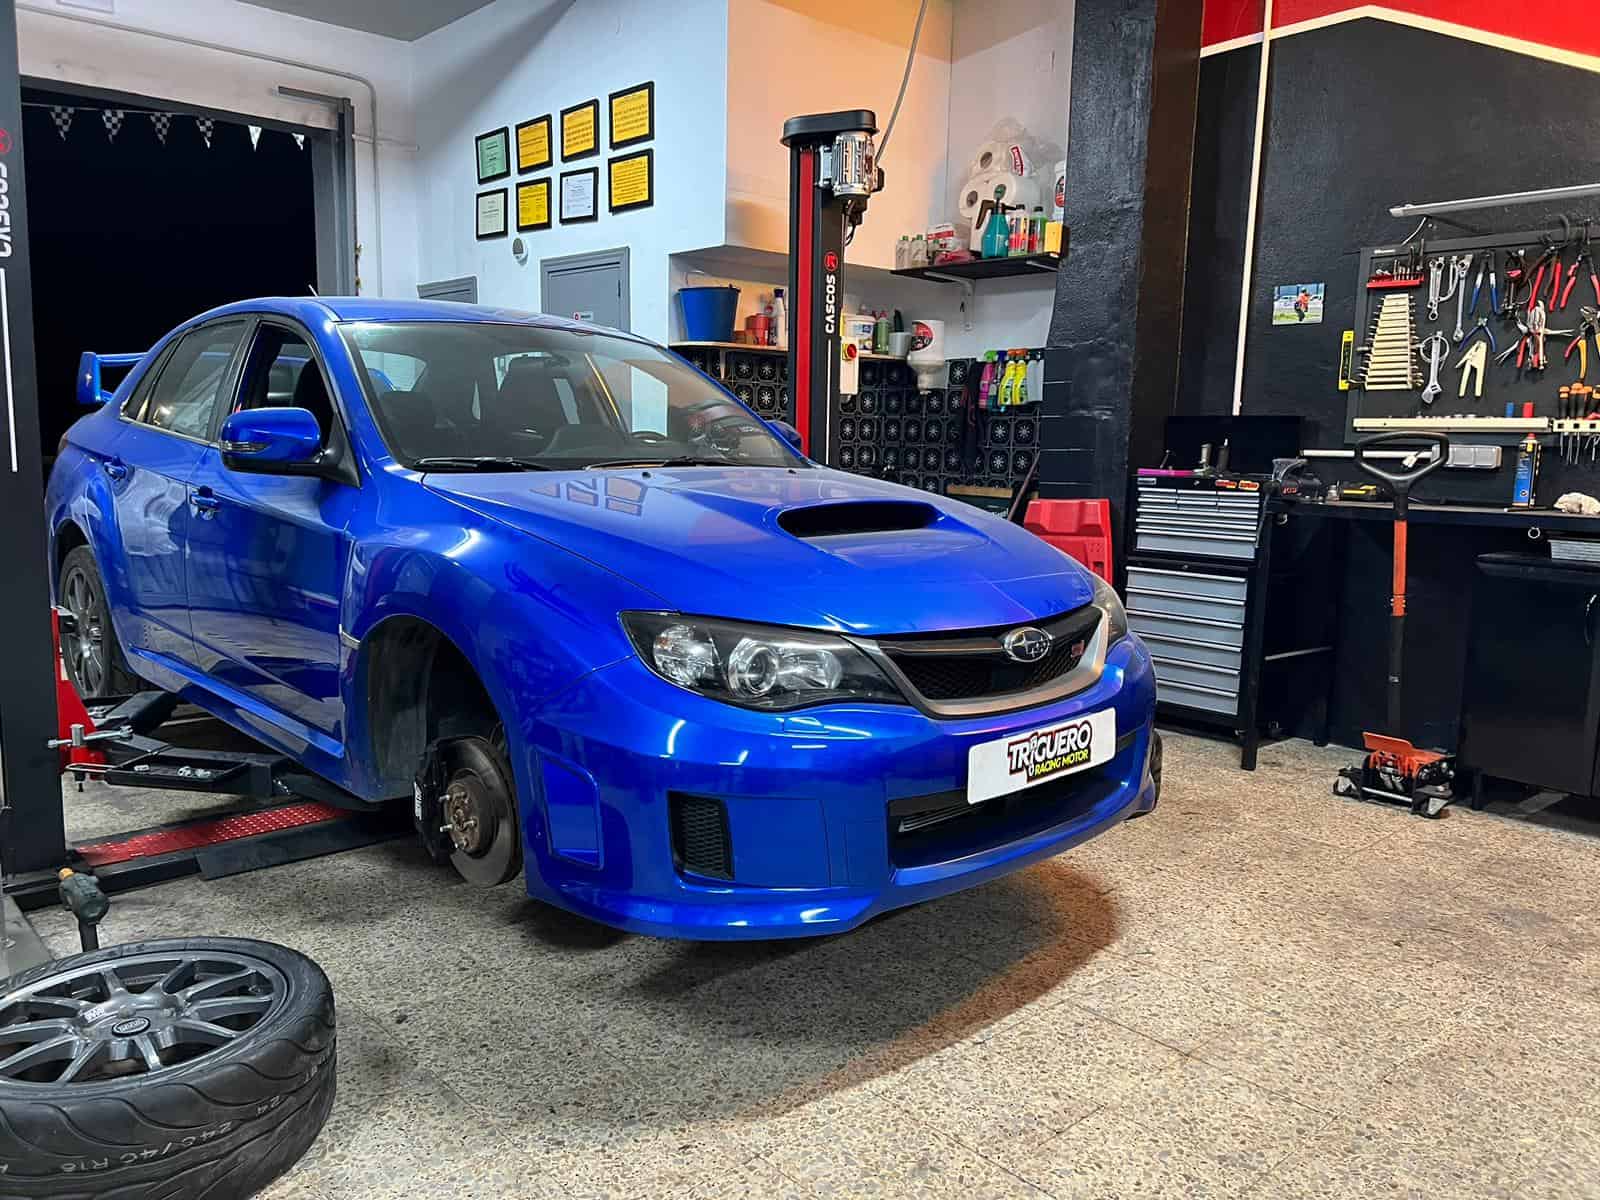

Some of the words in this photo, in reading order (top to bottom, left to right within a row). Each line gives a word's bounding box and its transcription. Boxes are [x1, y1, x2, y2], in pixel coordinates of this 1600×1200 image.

[825, 274, 836, 334] CASCOS
[1009, 723, 1090, 772] TRIGUERO
[1035, 757, 1061, 776] RACING
[1062, 749, 1089, 767] MOTOR
